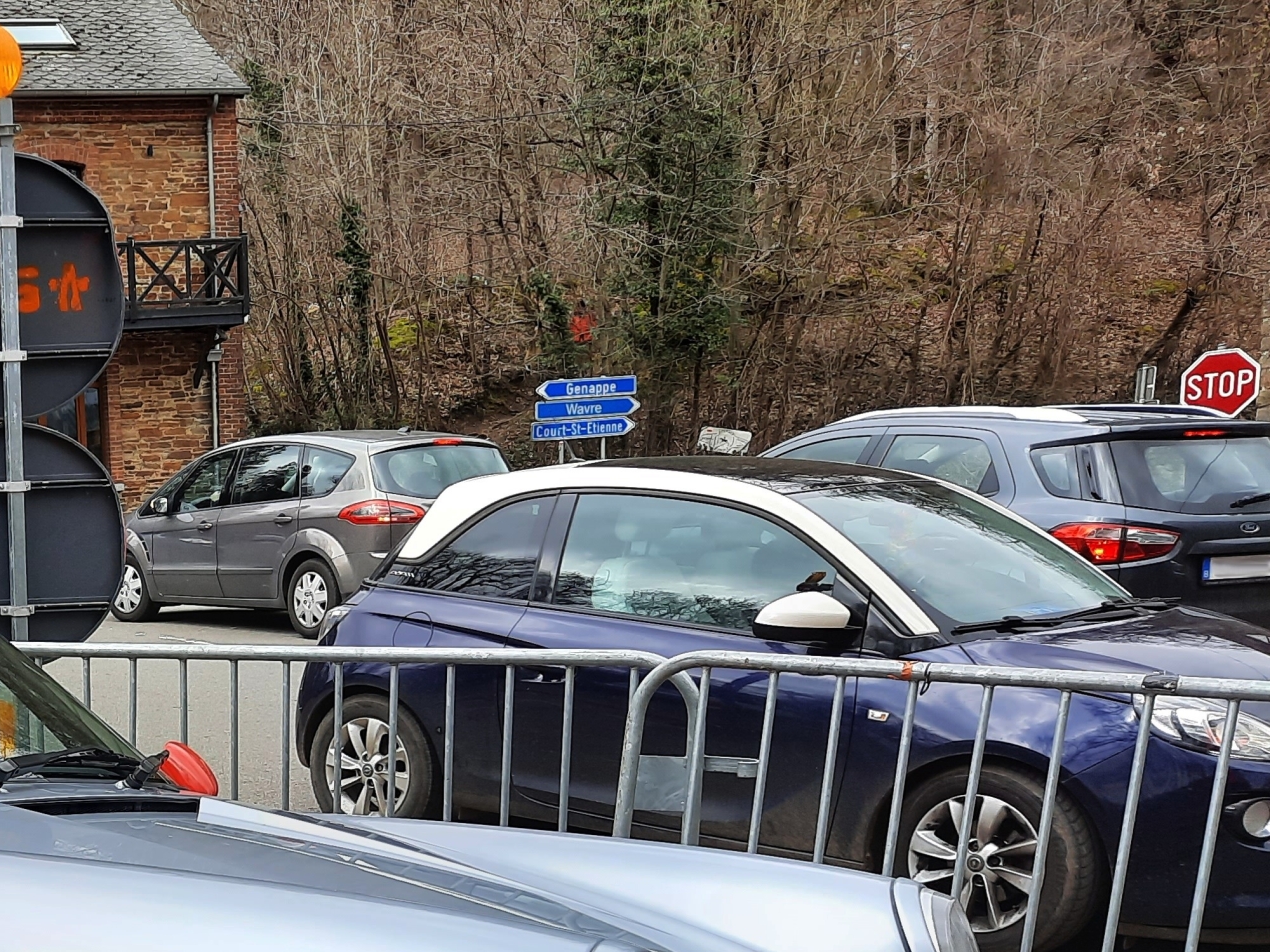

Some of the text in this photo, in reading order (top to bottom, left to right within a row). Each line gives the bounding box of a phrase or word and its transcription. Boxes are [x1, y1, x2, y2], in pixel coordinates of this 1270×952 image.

[566, 382, 617, 396] Genappe
[1187, 369, 1253, 400] STOP
[566, 403, 602, 415] Wavre
[536, 422, 623, 438] Court-St-Etienne
